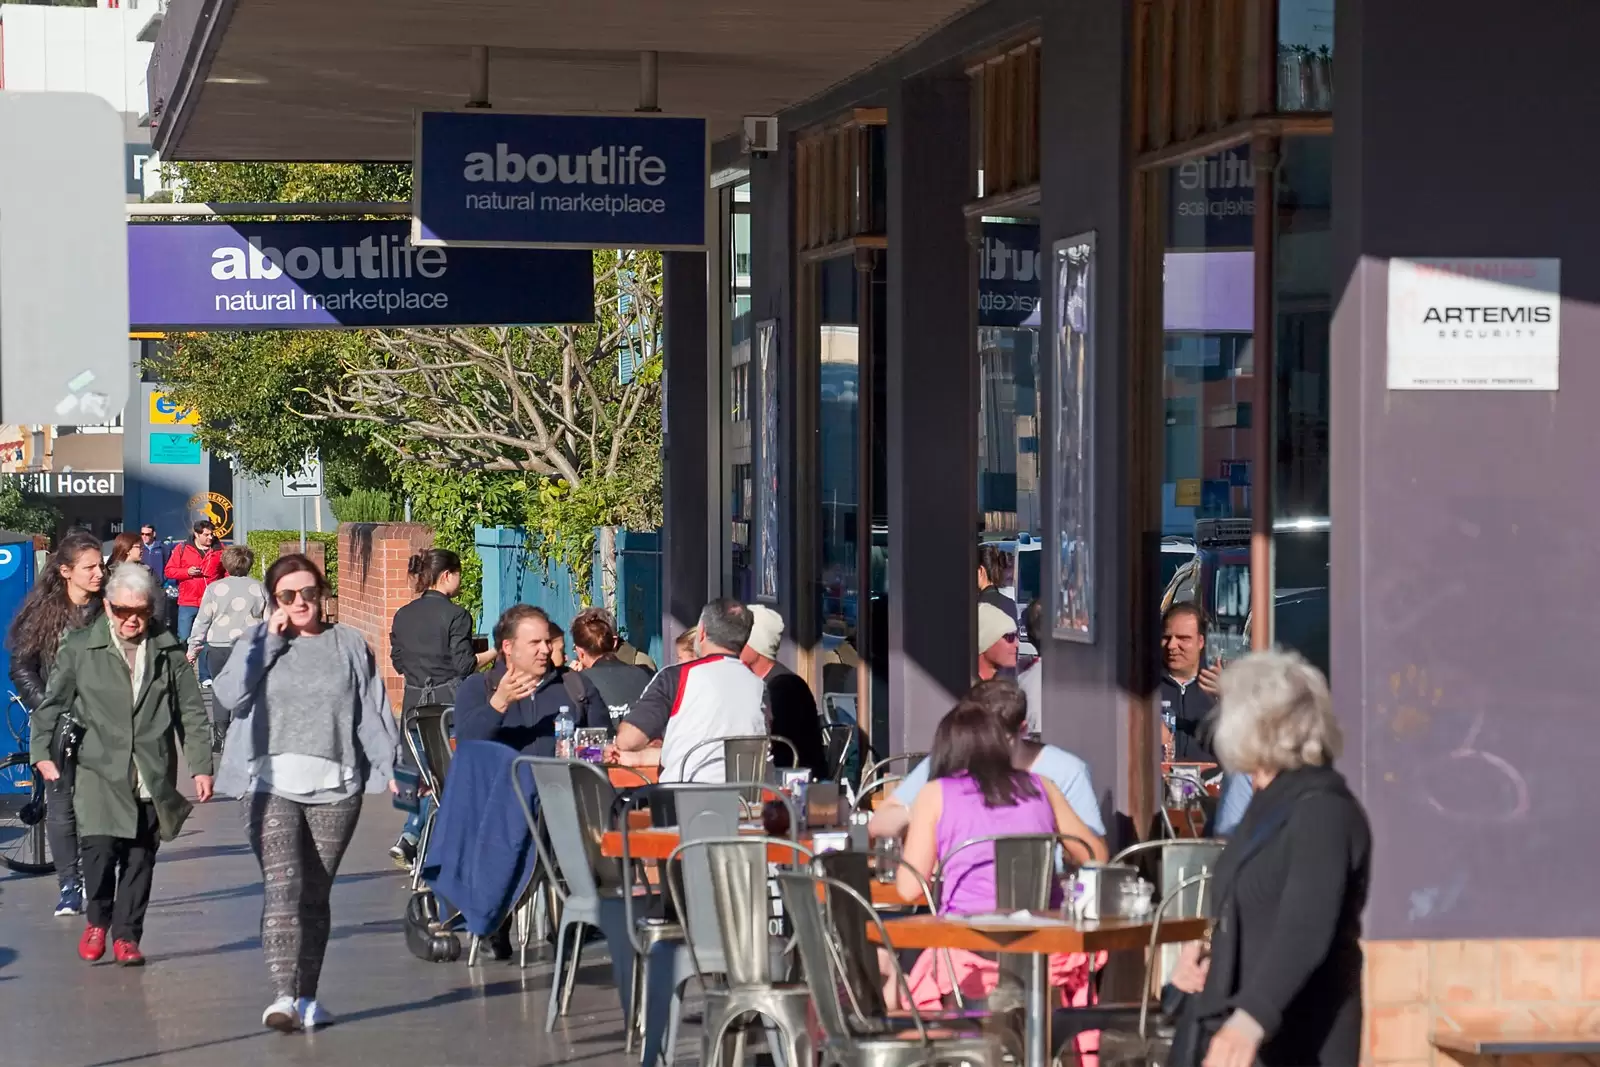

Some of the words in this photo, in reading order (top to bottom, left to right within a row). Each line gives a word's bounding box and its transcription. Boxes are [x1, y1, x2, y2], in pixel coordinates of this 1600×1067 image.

[463, 143, 666, 186] aboutlife
[465, 191, 535, 210] natural
[540, 192, 666, 216] marketplace
[211, 235, 447, 280] aboutlife
[215, 288, 296, 311] natural
[303, 288, 449, 315] marketplace
[1423, 306, 1551, 324] ARTEMIS
[1438, 329, 1536, 339] SECURITY
[57, 473, 115, 494] Hotel
